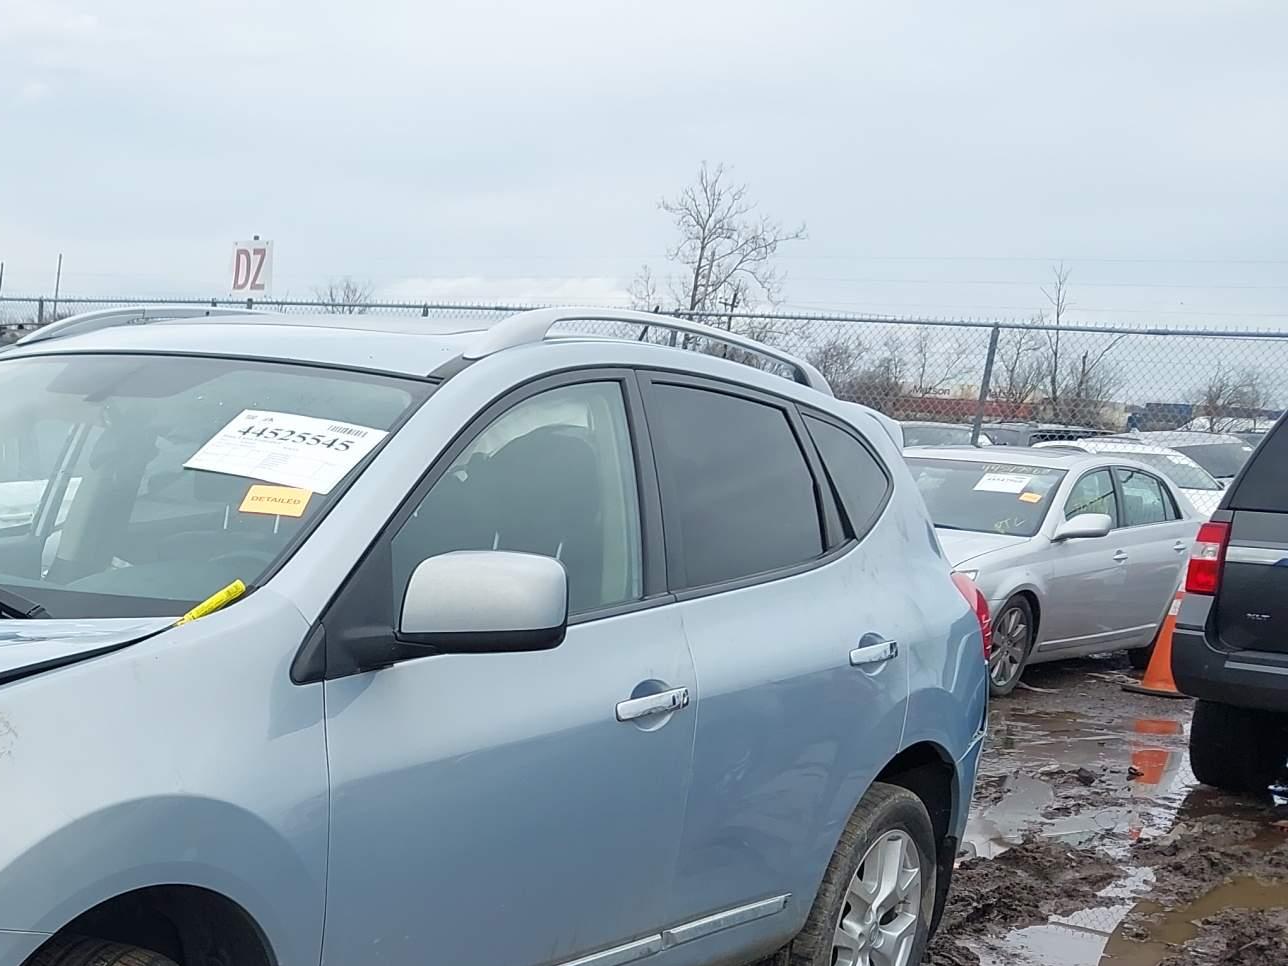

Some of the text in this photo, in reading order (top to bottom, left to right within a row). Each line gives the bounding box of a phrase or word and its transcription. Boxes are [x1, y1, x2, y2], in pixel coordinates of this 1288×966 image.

[233, 248, 266, 291] DZ
[237, 425, 356, 452] 44525545
[250, 495, 301, 505] DETAILED
